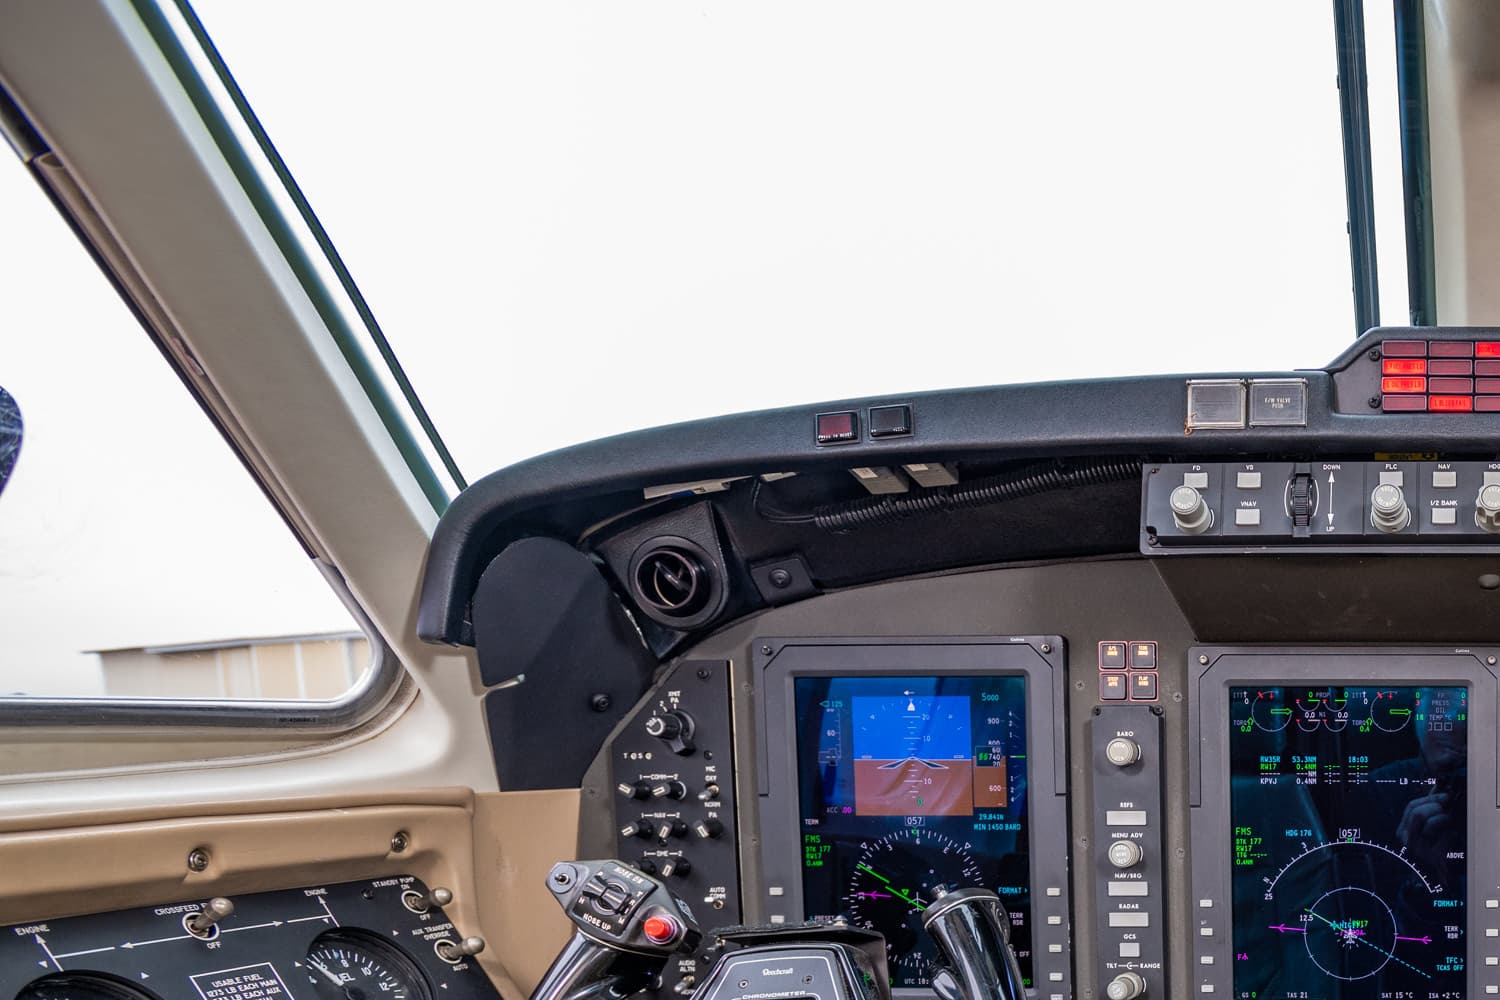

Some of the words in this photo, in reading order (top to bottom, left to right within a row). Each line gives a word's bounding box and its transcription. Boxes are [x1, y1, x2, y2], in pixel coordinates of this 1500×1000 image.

[1341, 829, 1358, 837] 057
[805, 835, 821, 843] FMS
[207, 941, 222, 950] OFF
[742, 991, 806, 1000] CHRONOMETER
